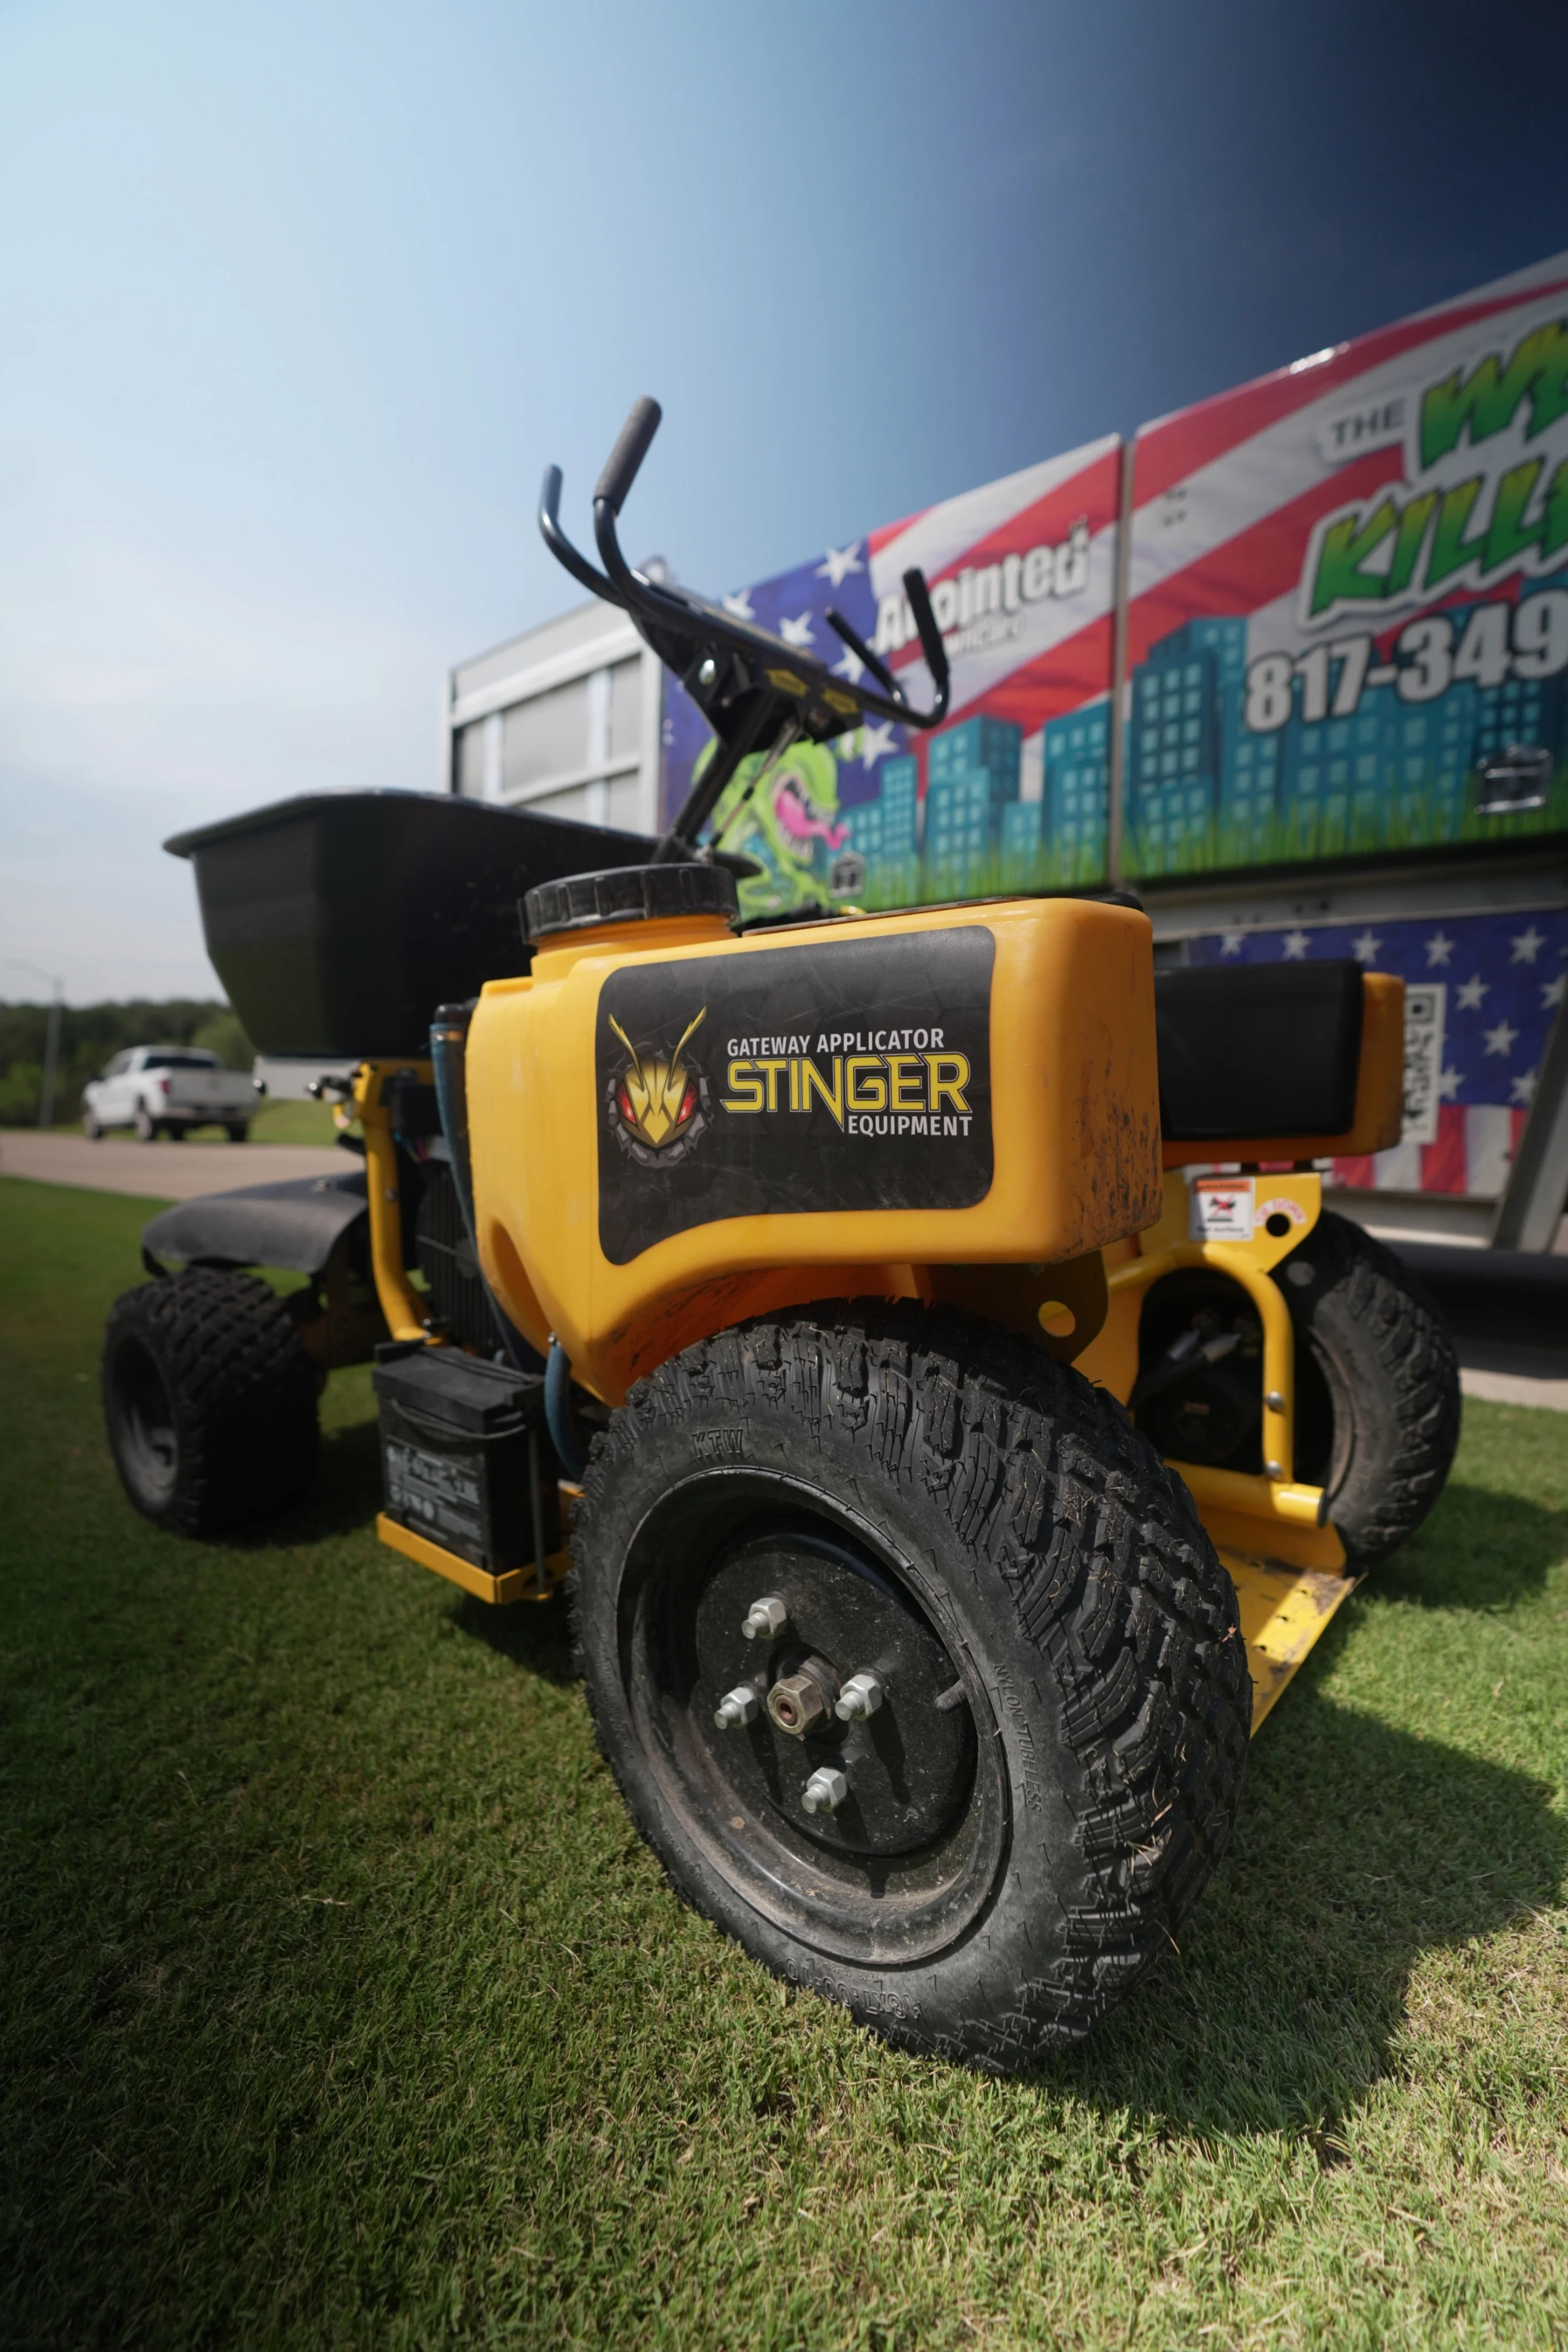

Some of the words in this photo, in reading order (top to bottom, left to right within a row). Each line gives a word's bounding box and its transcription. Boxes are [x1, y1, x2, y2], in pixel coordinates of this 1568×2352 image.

[1330, 395, 1407, 449] THE
[1244, 591, 1568, 733] 817-349
[726, 1035, 811, 1057] GATEWAY
[816, 1028, 945, 1053] APPLICATOR
[719, 1051, 973, 1133] STINGER
[848, 1115, 973, 1138] EQUIPMENT
[691, 1428, 744, 1457] KTW
[993, 1664, 1026, 1718] NYLON
[1016, 1723, 1042, 1813] TUBELESS
